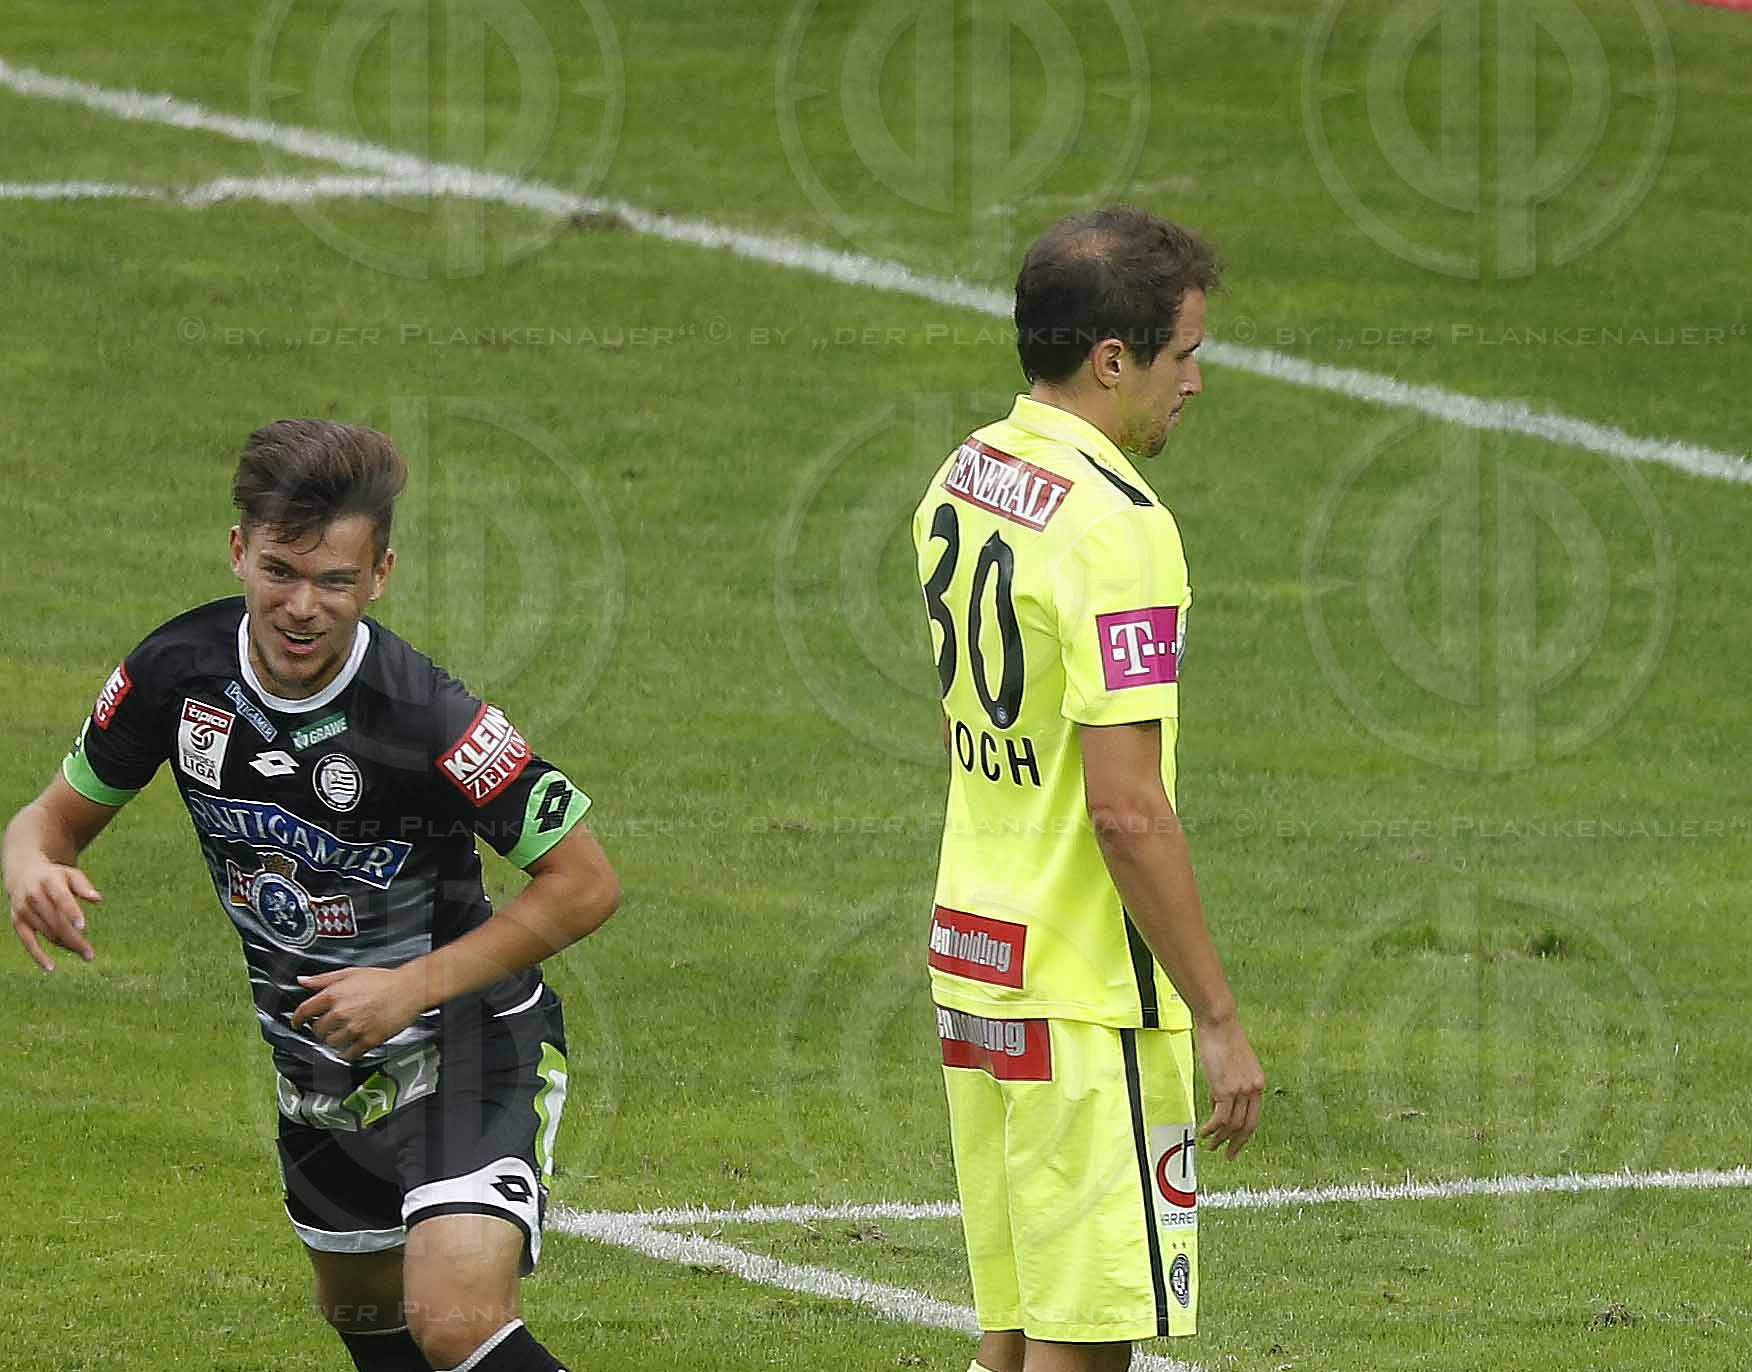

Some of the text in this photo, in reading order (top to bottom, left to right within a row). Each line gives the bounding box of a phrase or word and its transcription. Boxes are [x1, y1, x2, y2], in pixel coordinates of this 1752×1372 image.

[923, 503, 1024, 729] 30
[188, 704, 228, 729] tipico
[183, 756, 217, 782] LIGA
